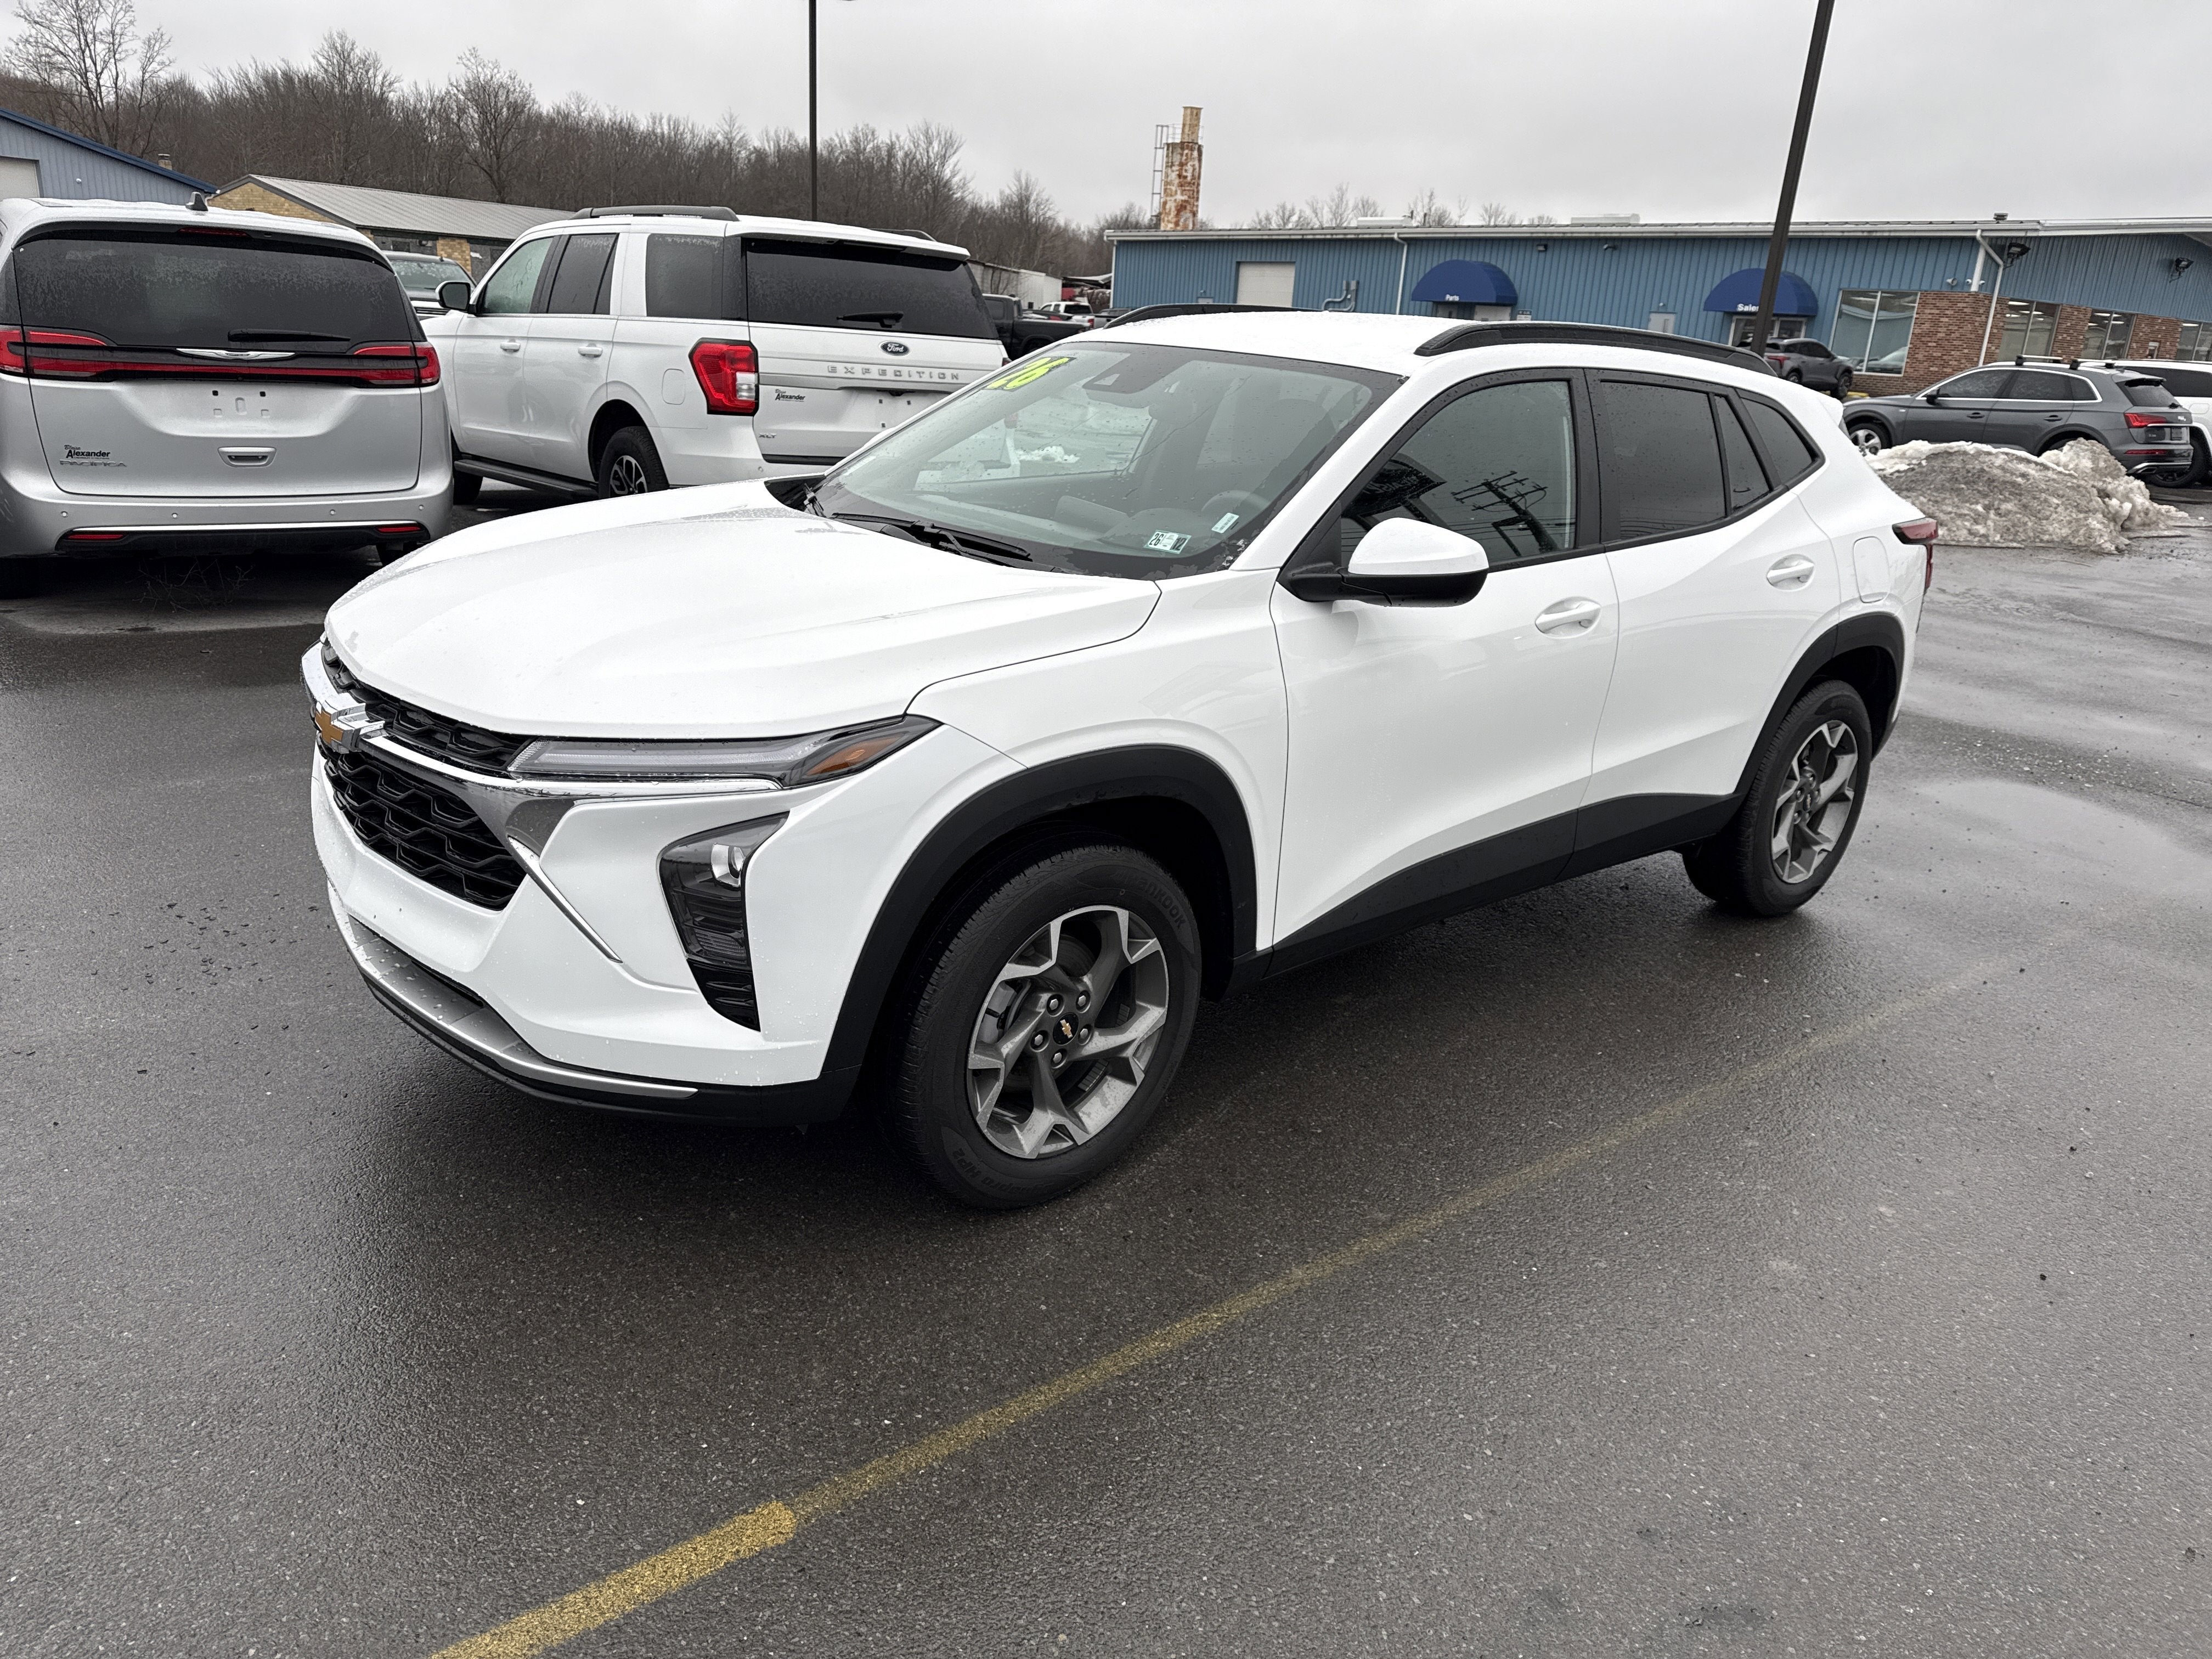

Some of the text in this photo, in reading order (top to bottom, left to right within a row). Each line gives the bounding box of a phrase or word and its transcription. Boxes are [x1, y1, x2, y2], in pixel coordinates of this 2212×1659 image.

[887, 342, 905, 353] Ford
[827, 364, 959, 380] EXPEDITION
[984, 357, 1070, 390] 26
[66, 449, 110, 459] Alexander
[1149, 532, 1187, 551] 26 12
